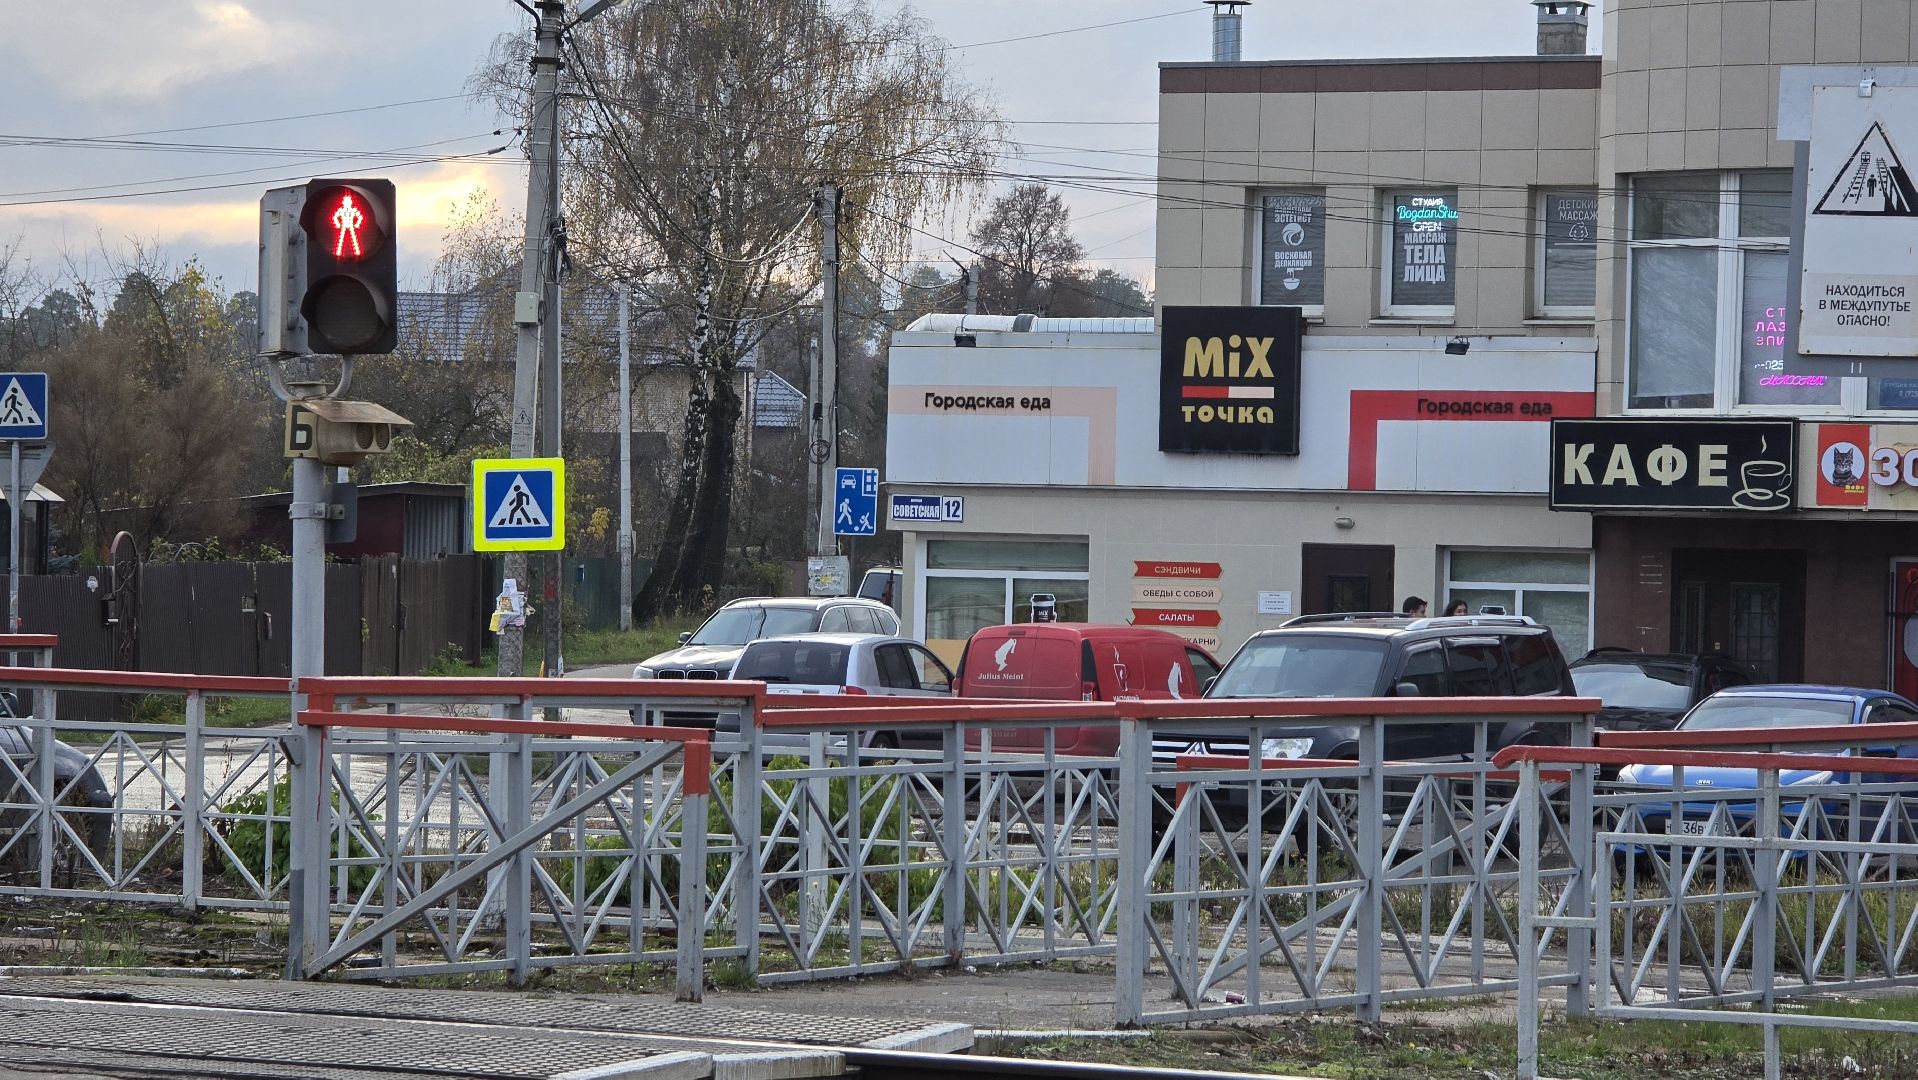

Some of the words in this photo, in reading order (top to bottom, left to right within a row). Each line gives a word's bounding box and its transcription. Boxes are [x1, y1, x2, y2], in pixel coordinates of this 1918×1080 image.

[1412, 197, 1443, 207] СТУДИЯ
[1274, 213, 1312, 223] ЭСТЕТИСТ
[1559, 210, 1599, 221] МАССАЖ
[1412, 221, 1442, 232] OPEN
[1404, 232, 1447, 244] МАССАЖ
[1274, 251, 1312, 260] ВОСКОВАЯ
[1404, 244, 1446, 264] ТЕЛА
[1274, 259, 1313, 269] ДЕПИЛЯЦИЯ
[1403, 264, 1446, 285] ЛИЦА
[1825, 285, 1905, 298] НАХОДИТЬСЯ
[1819, 299, 1827, 310] В
[1830, 299, 1911, 312] МЕЖДУПУТЬЕ
[1837, 314, 1891, 327] ОПАСНО!
[1182, 334, 1275, 378] MiX
[925, 392, 1015, 411] Городская
[1020, 396, 1051, 411] еда
[1417, 398, 1514, 416] Городская
[1520, 402, 1553, 416] еда
[290, 404, 313, 450] Б
[1563, 443, 1729, 487] КАФЕ
[893, 504, 940, 518] СОВЕТСКАЯ
[944, 500, 961, 518] 12
[1154, 566, 1201, 574] СЭНДВИЧИ
[1142, 589, 1173, 598] ОБЕДЫ
[1183, 589, 1214, 598] СОБОЙ
[1158, 613, 1195, 622] САЛАТЫ
[1184, 637, 1216, 646] КАРНИ
